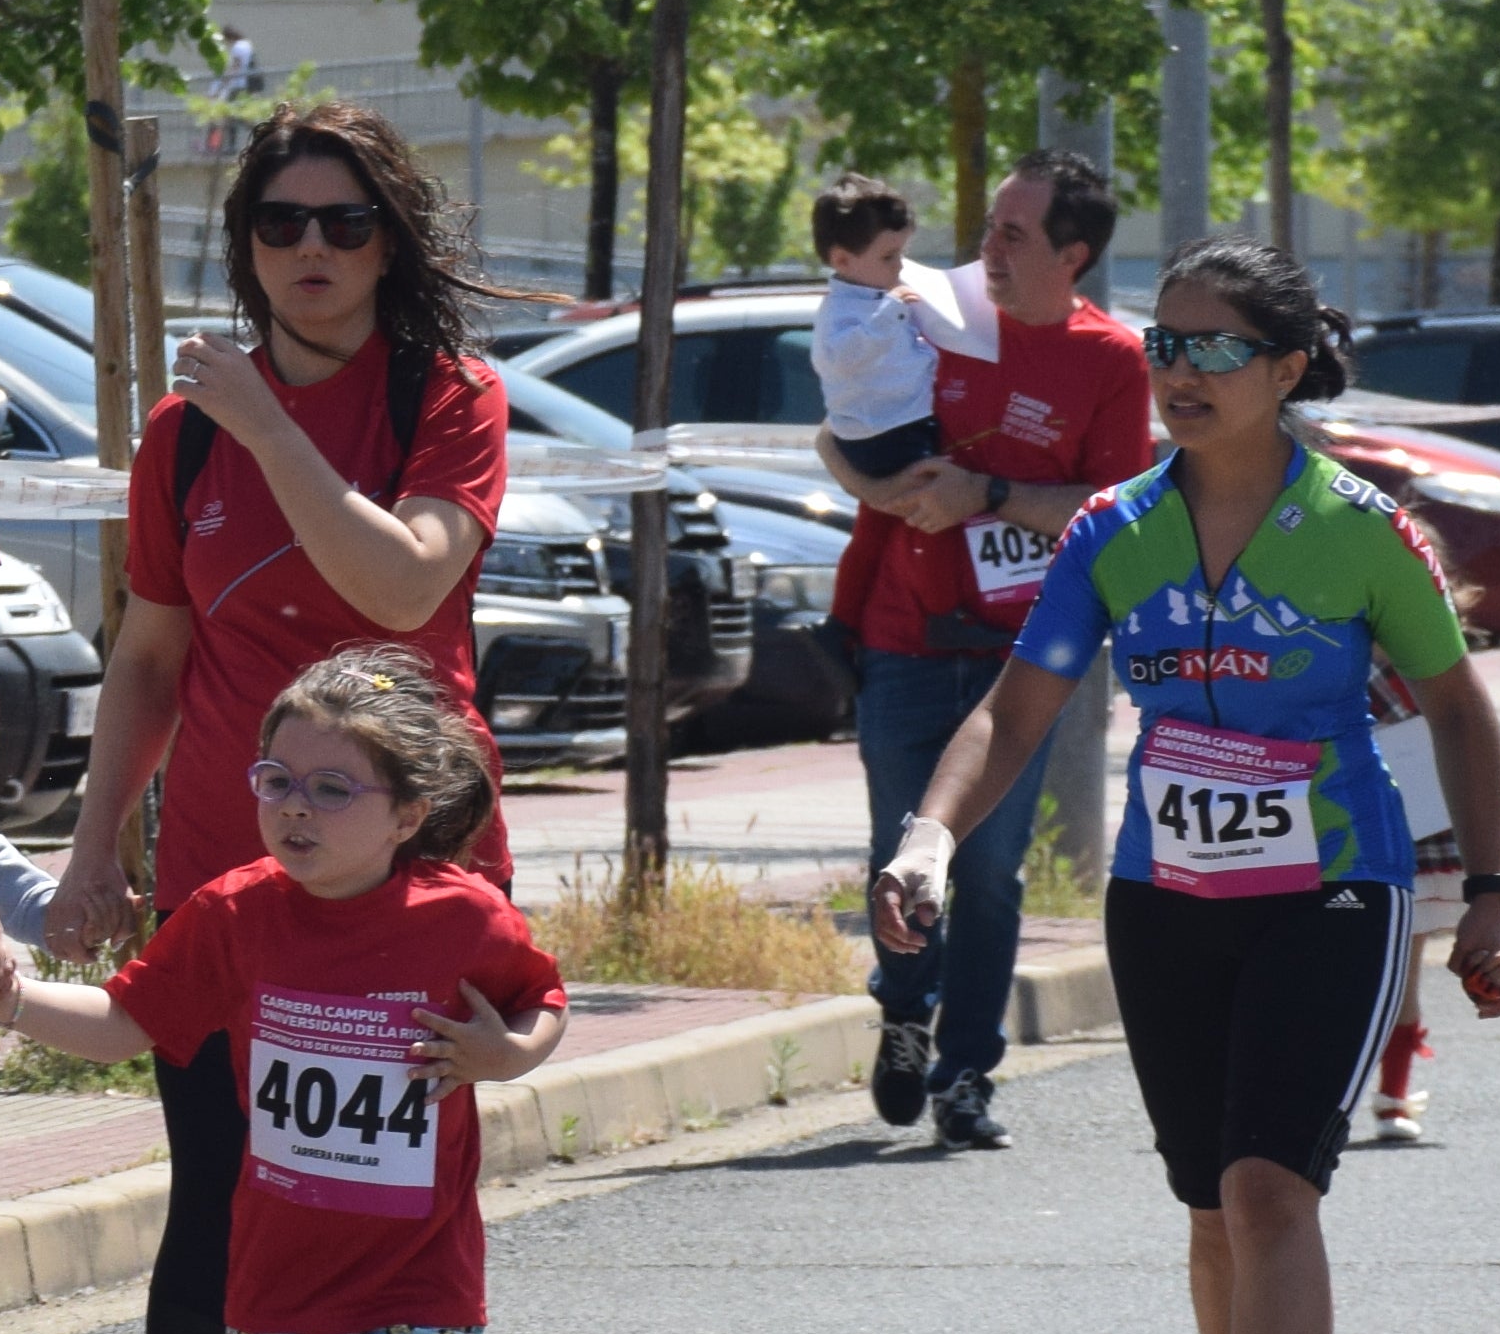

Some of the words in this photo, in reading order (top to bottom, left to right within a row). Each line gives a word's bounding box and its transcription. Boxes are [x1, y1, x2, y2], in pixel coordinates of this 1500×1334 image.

[1154, 737, 1234, 762] UNIVERSIDAD
[1235, 754, 1255, 765] DE
[1255, 756, 1272, 768] LA
[1156, 725, 1210, 745] CARRERA
[1213, 737, 1266, 755] CAMPUS
[1157, 783, 1292, 844] 4125
[260, 994, 322, 1017] CARRERA
[324, 1006, 389, 1023] CAMPUS
[260, 1008, 353, 1034] UNIVERSIDAD
[355, 1023, 376, 1036] DE
[378, 1026, 398, 1039] LA
[259, 1029, 301, 1048] DOMINGO
[315, 1041, 329, 1051] DE
[330, 1043, 361, 1055] MAYO
[363, 1047, 378, 1058] DE
[379, 1049, 405, 1059] 2022
[257, 1059, 429, 1148] 4044
[291, 1144, 333, 1161] CARRERA
[334, 1152, 380, 1167] FAMILIAR
